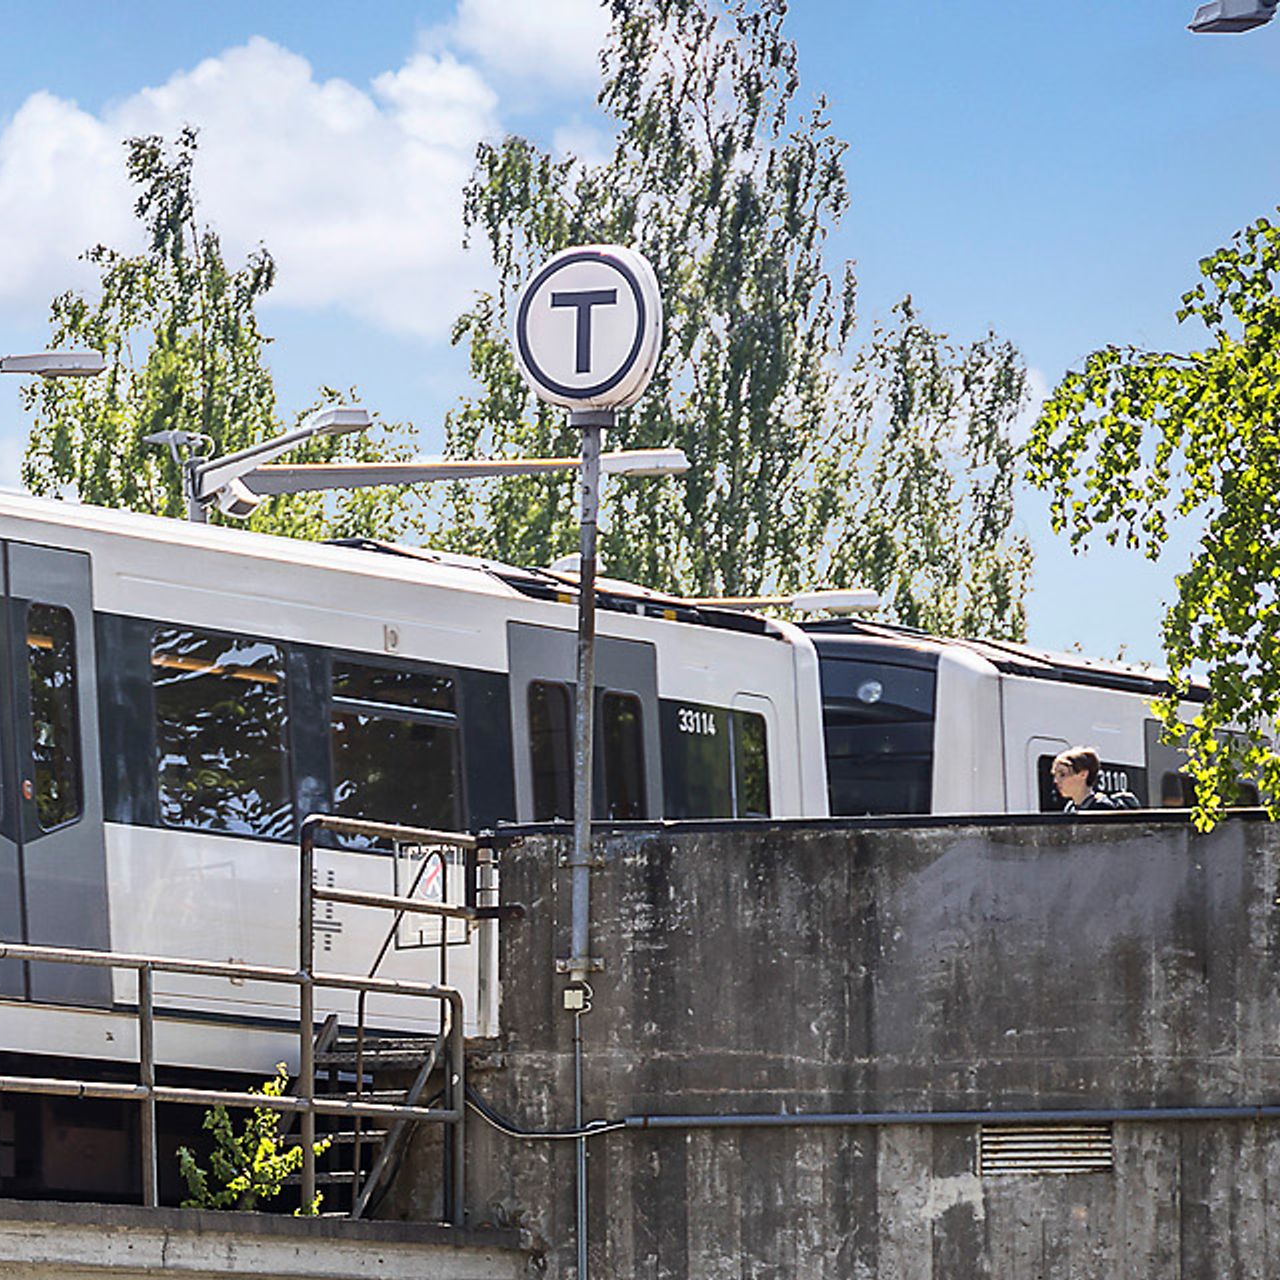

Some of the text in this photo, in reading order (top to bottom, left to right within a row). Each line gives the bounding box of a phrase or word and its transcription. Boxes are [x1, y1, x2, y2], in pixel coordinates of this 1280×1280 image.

[550, 288, 617, 373] T
[678, 708, 716, 735] 33114
[1097, 769, 1128, 793] 3110
